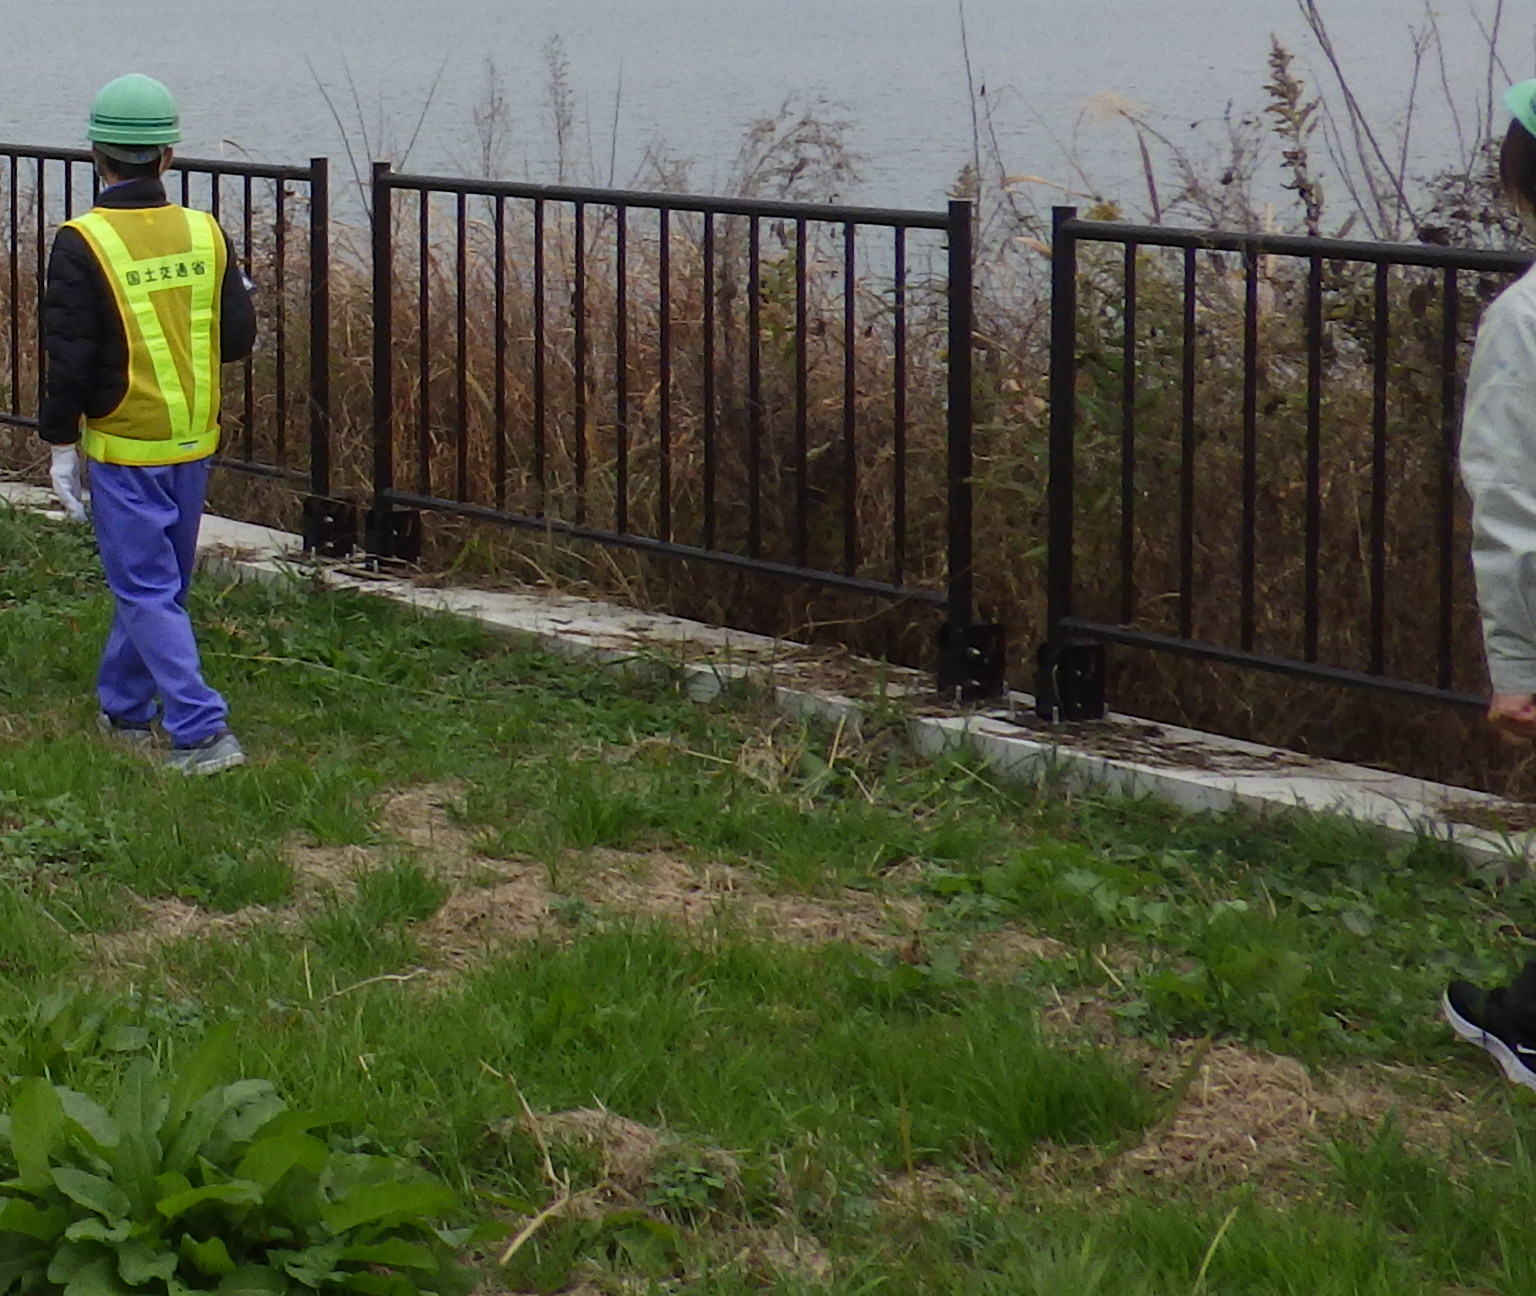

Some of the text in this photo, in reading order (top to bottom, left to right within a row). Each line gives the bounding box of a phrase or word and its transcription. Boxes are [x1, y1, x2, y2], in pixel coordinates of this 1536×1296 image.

[126, 260, 205, 286] 国土交通省
